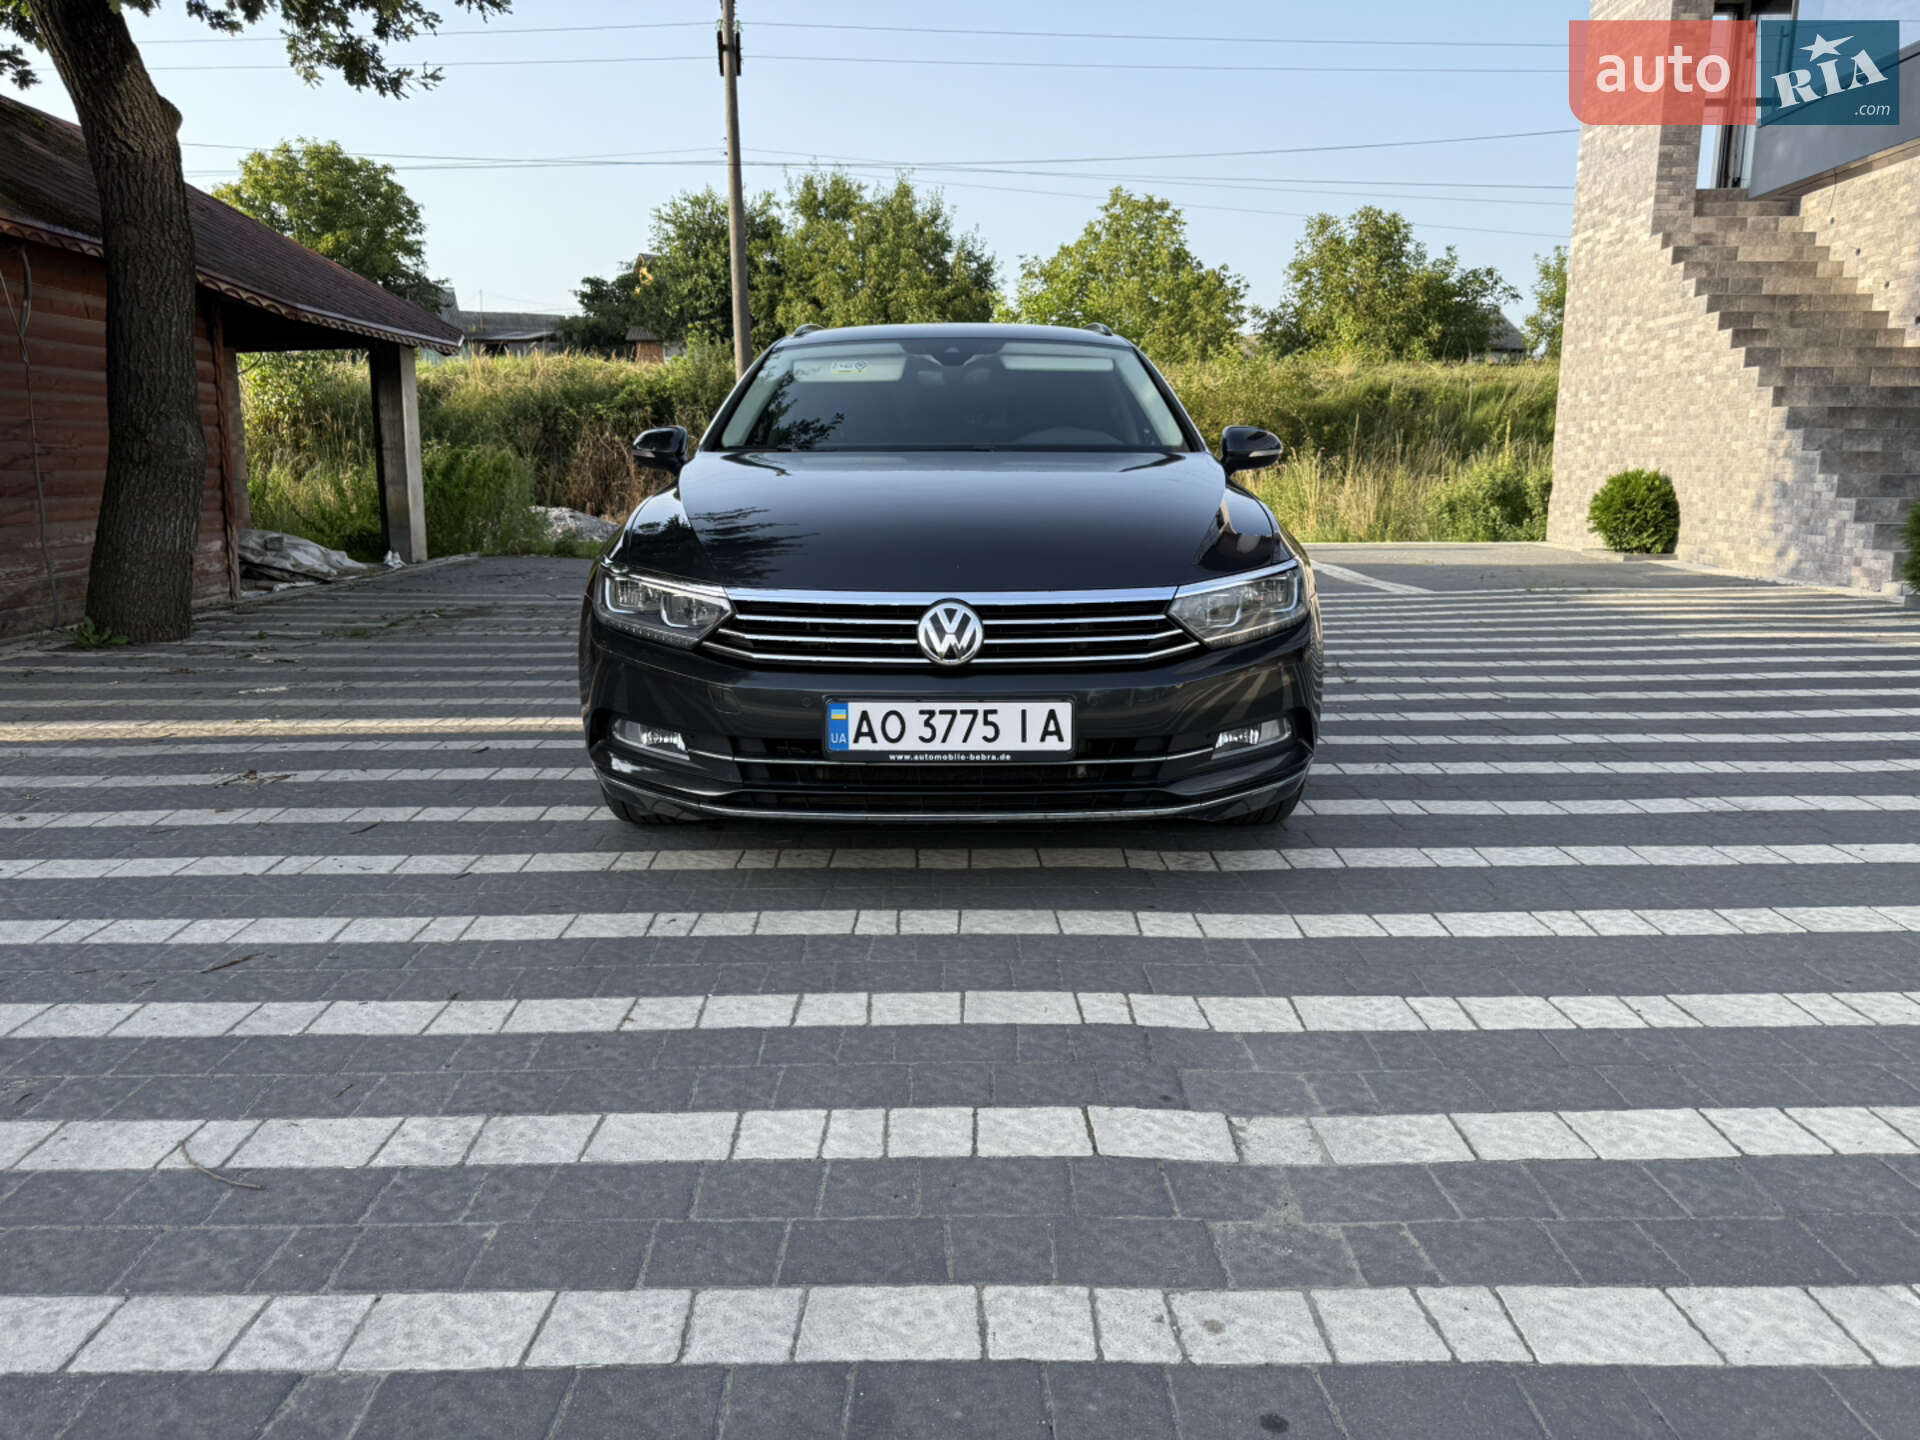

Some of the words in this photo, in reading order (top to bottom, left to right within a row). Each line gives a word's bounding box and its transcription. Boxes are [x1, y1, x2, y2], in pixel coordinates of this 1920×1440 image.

[853, 709, 906, 744] AO
[918, 709, 1000, 744] 3775
[830, 733, 847, 744] UA
[888, 753, 1011, 761] www.automobile-bebra.de
